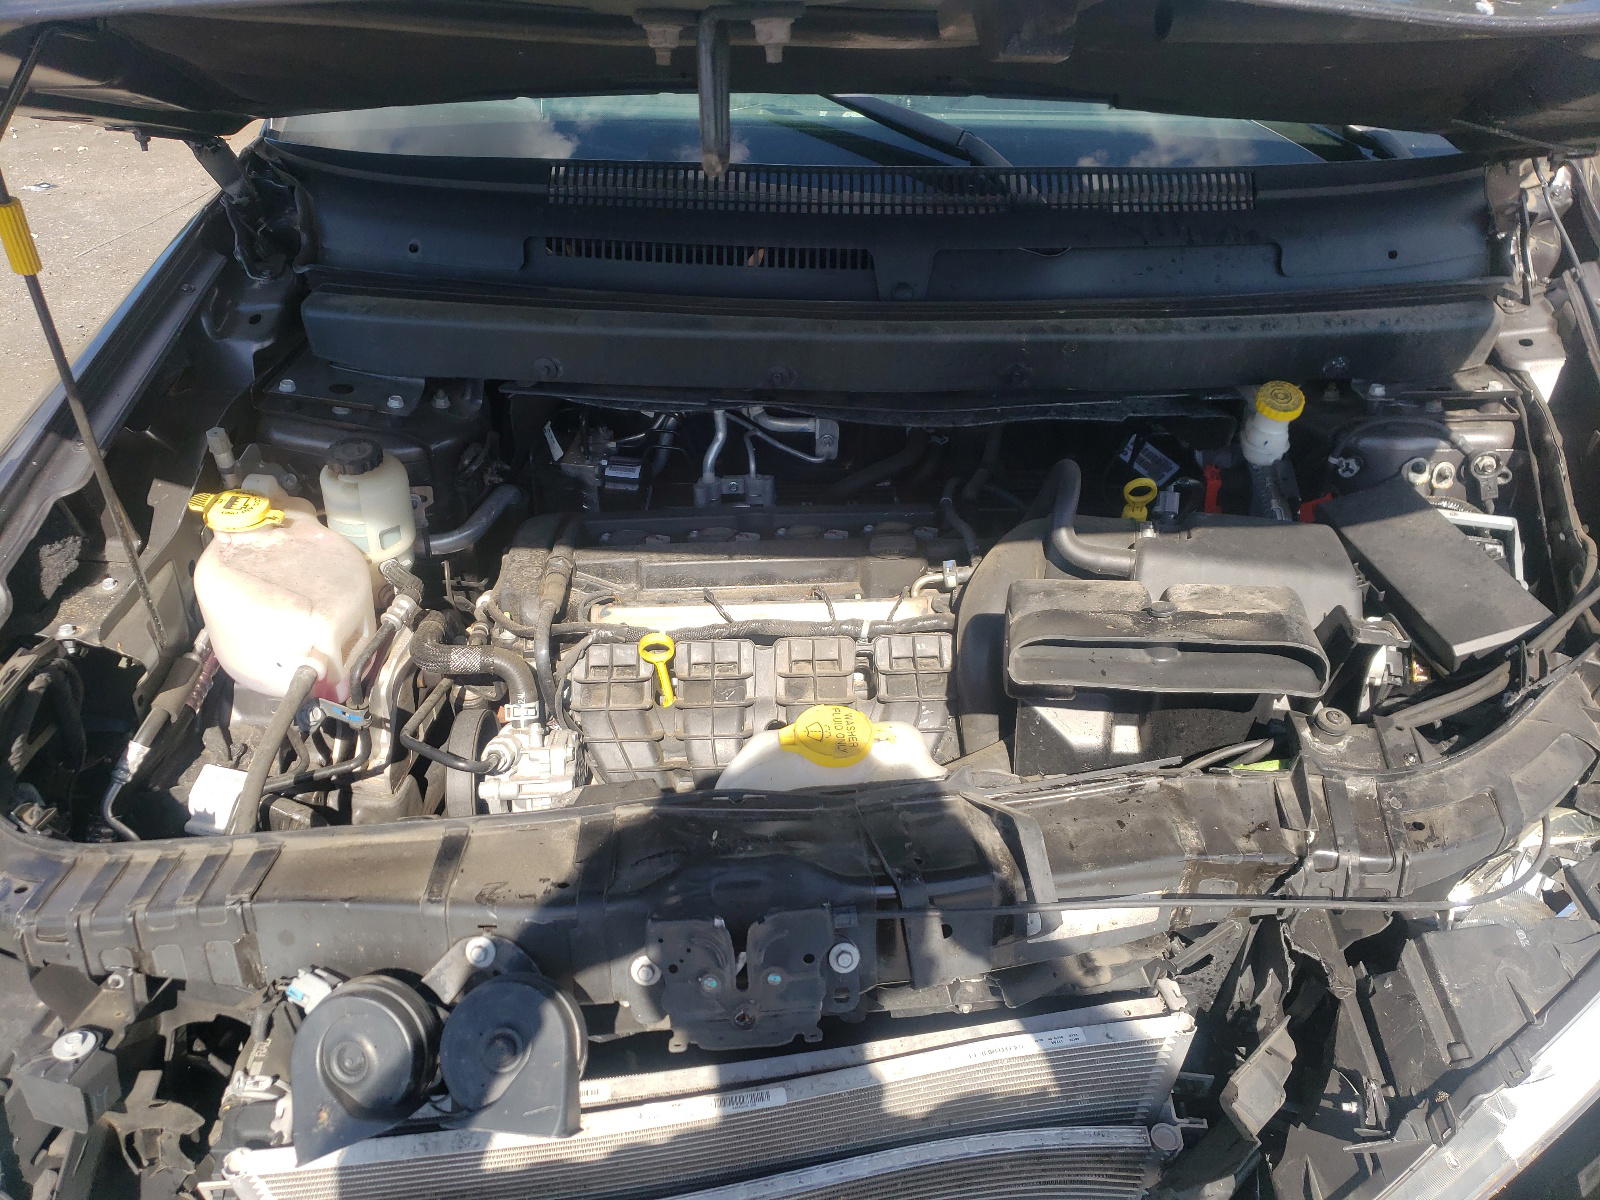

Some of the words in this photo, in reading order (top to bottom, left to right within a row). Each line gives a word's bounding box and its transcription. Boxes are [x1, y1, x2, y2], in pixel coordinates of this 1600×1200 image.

[832, 707, 844, 731] FLUID
[844, 713, 858, 748] WASHER
[836, 733, 849, 753] ONLY
